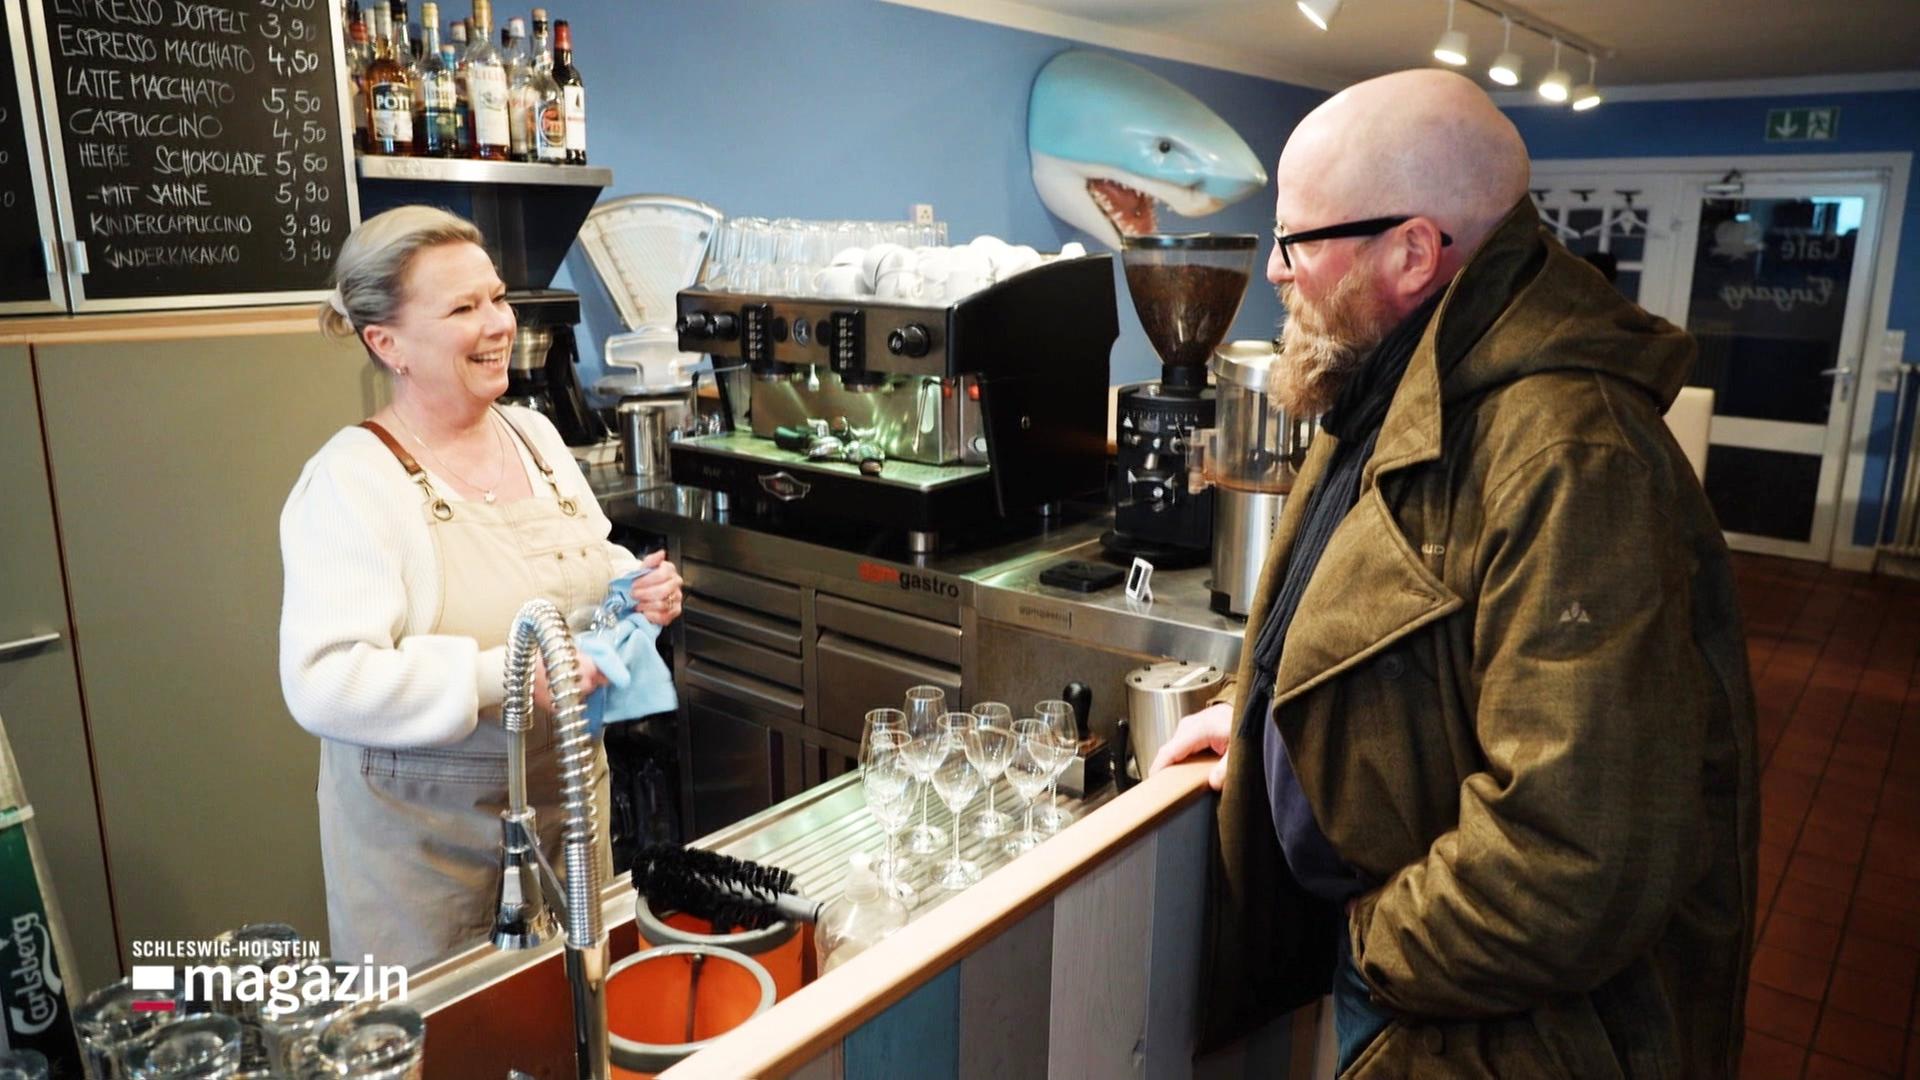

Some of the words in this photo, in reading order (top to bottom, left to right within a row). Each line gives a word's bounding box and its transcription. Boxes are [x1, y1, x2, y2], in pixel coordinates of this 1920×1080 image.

[172, 1, 249, 34] DOPPELT
[259, 13, 316, 47] 3,90
[59, 24, 157, 62] ESPRESSO
[164, 38, 255, 74] MACCHIATO
[268, 45, 319, 78] 4,50
[67, 66, 124, 100] LATTE
[130, 72, 235, 108] MACCHIATO
[262, 87, 321, 119] 5,50
[69, 108, 223, 138] CAPPUCCINO
[273, 119, 326, 150] 4,50
[153, 144, 268, 178] SCHOKOLADE
[146, 183, 212, 207] SAHNE
[275, 181, 330, 211] 5,90
[90, 212, 252, 236] KINDERCAPPUCCINO
[280, 214, 331, 238] 3,90
[280, 238, 331, 266] 3,90
[10, 912, 62, 1035] Carlsberg
